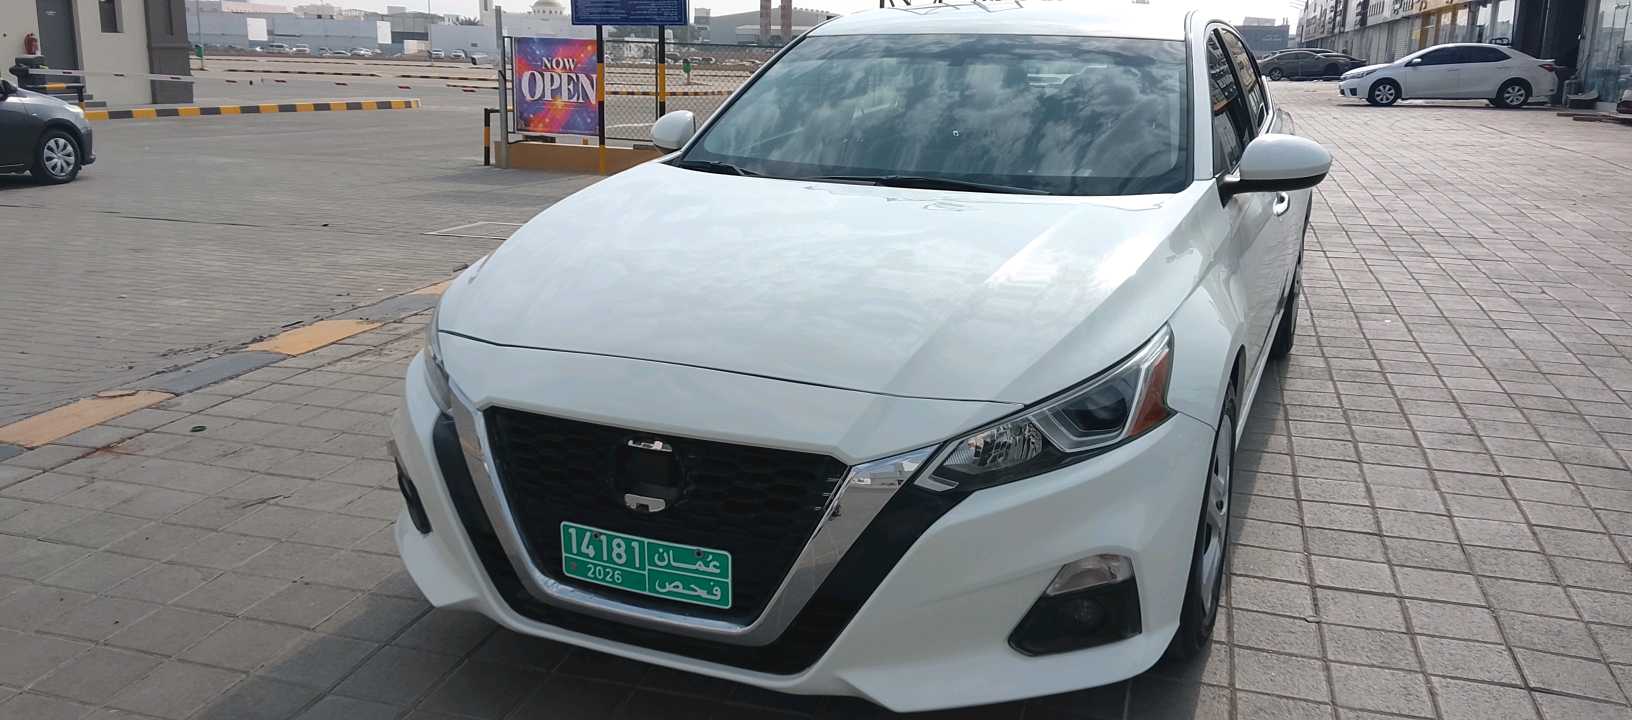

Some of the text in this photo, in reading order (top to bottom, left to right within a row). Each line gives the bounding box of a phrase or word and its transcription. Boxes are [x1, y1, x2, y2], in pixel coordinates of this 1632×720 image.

[542, 57, 576, 70] NOW
[521, 70, 597, 104] OPEN
[568, 527, 640, 568] 14181
[586, 564, 623, 584] 2026
[655, 578, 722, 601] فحص
